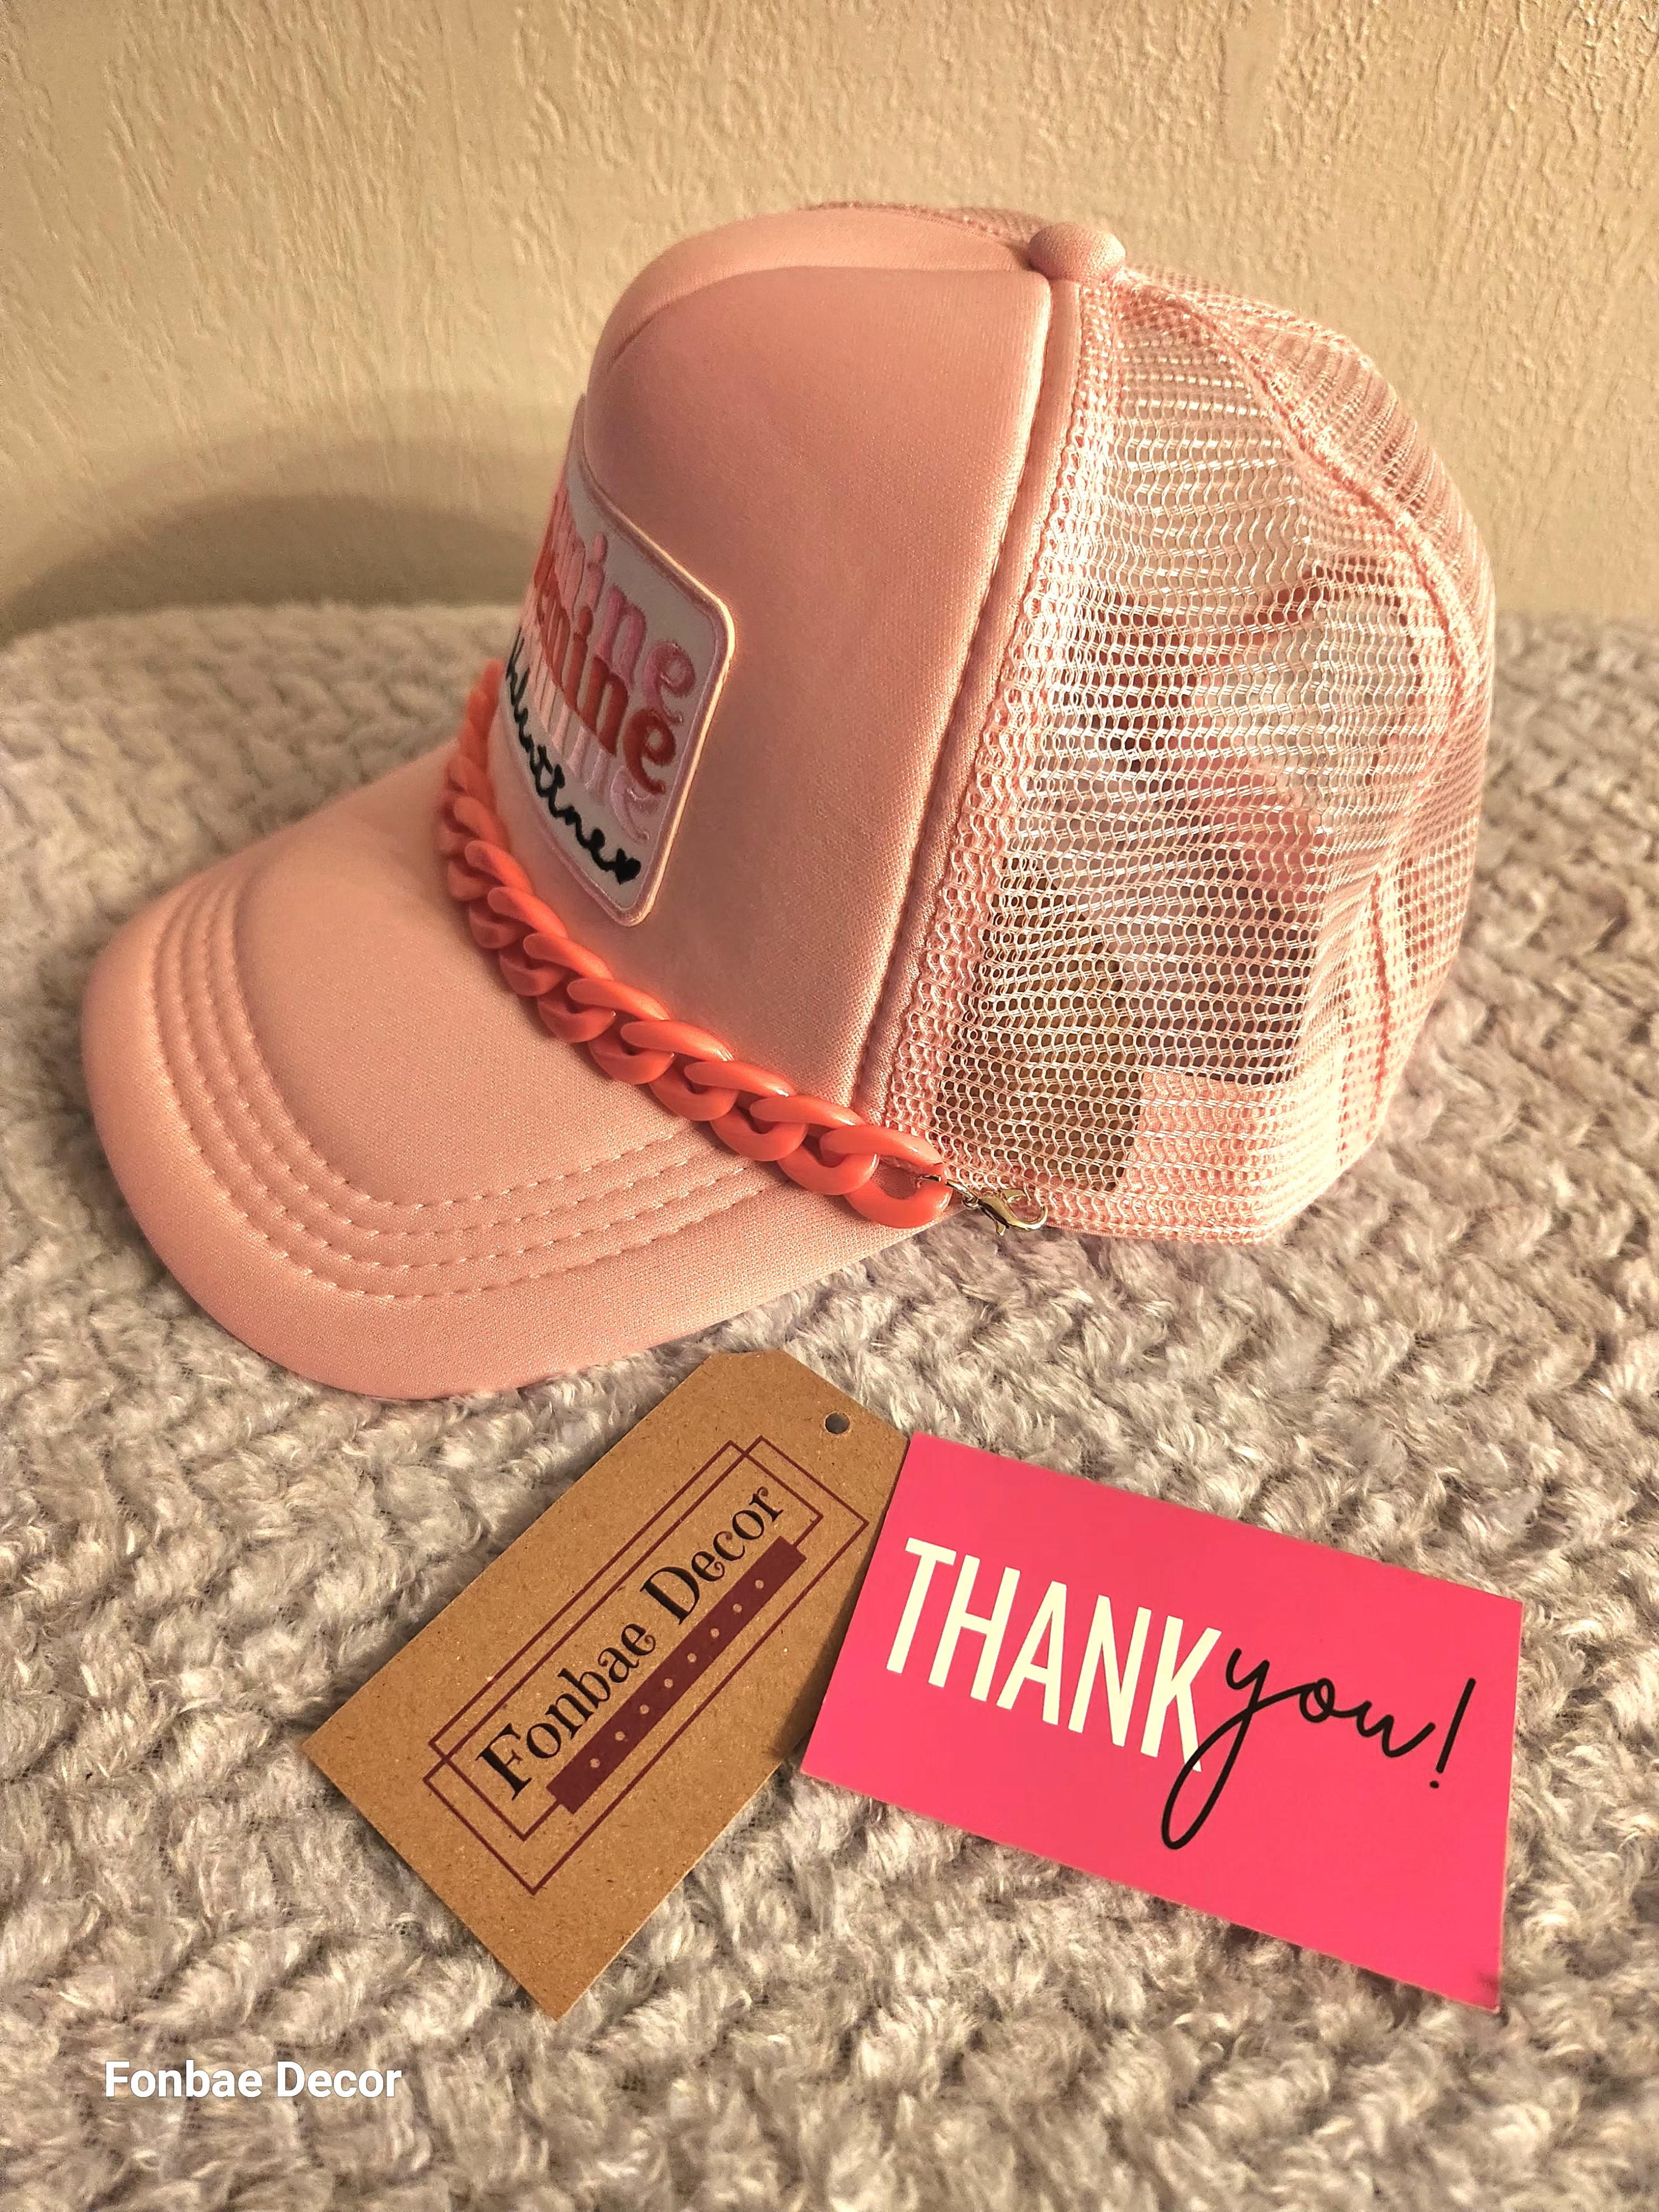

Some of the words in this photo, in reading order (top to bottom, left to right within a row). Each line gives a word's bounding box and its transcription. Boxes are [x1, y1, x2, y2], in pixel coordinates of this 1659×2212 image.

[476, 1623, 656, 1801] Fonbae
[640, 1486, 784, 1625] Decor
[886, 1537, 1222, 1772] THANK
[1160, 1648, 1477, 1850] you!
